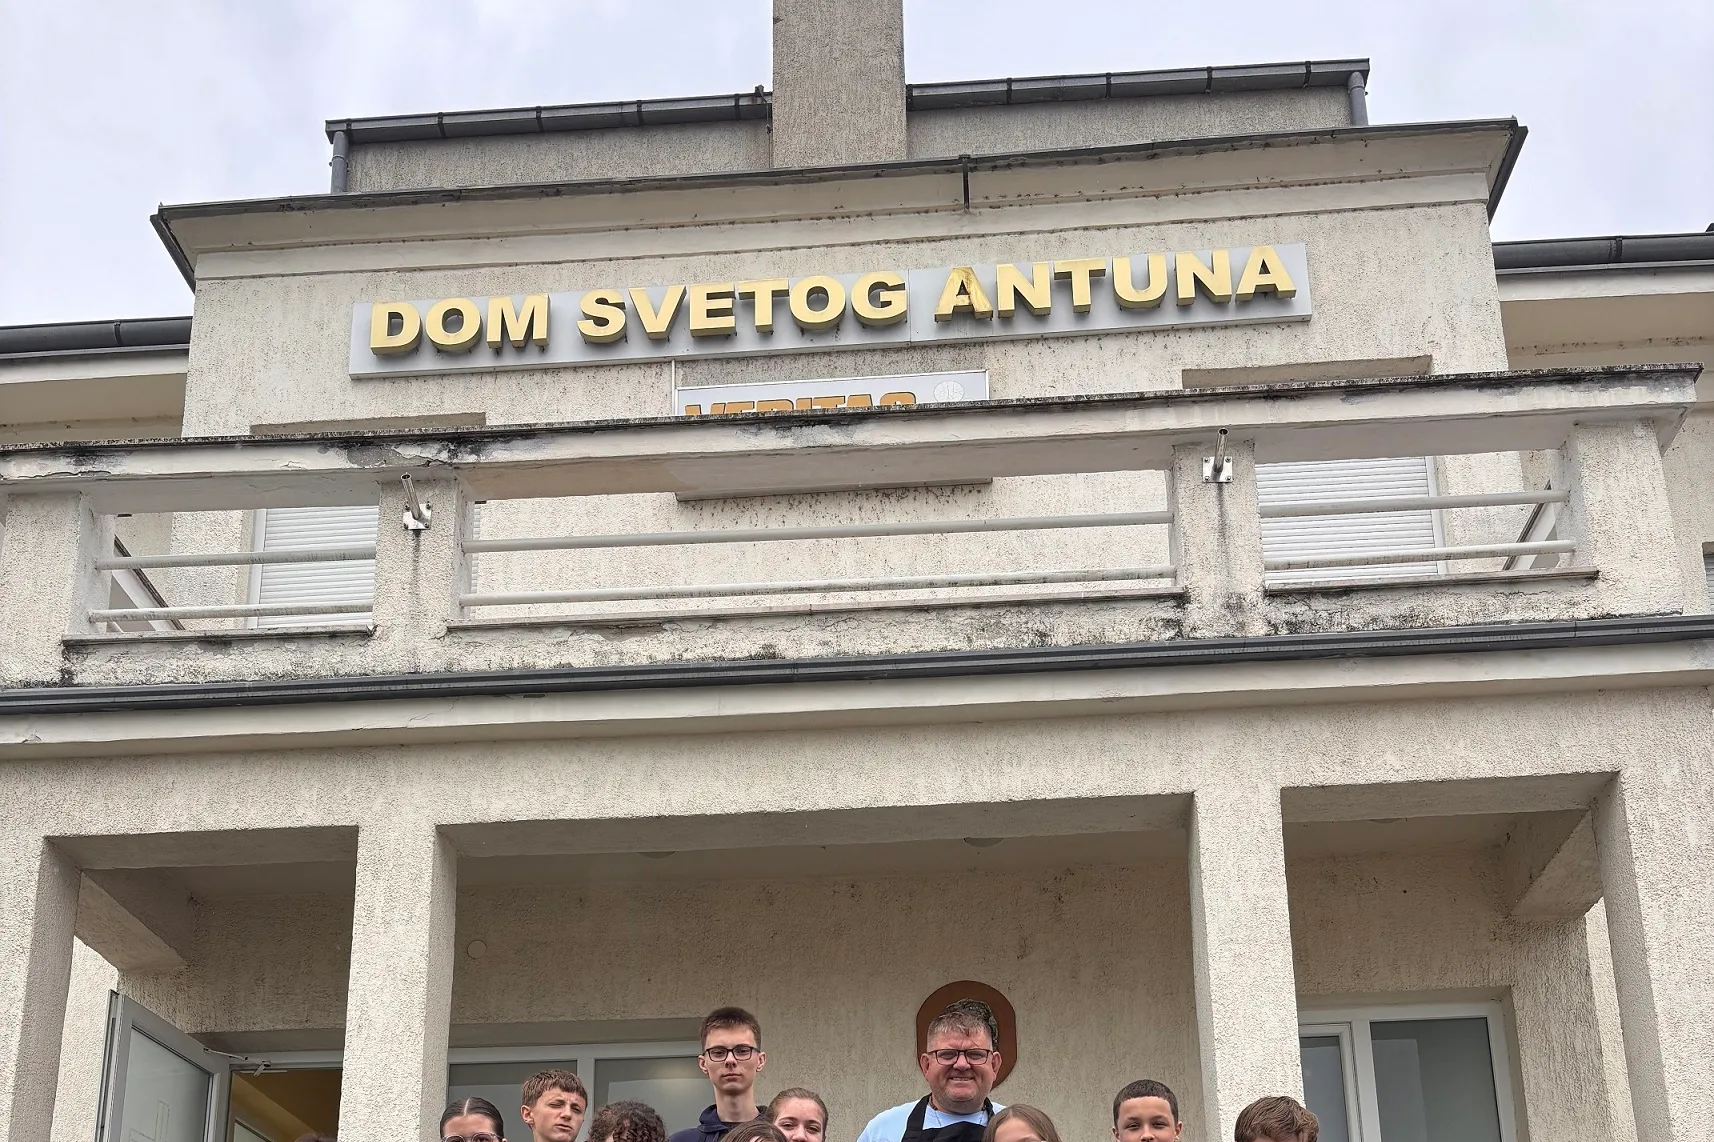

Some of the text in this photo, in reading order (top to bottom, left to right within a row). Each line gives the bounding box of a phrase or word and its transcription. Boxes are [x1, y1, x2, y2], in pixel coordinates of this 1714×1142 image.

[370, 245, 1297, 356] DOM SVETOG ANTUNA
